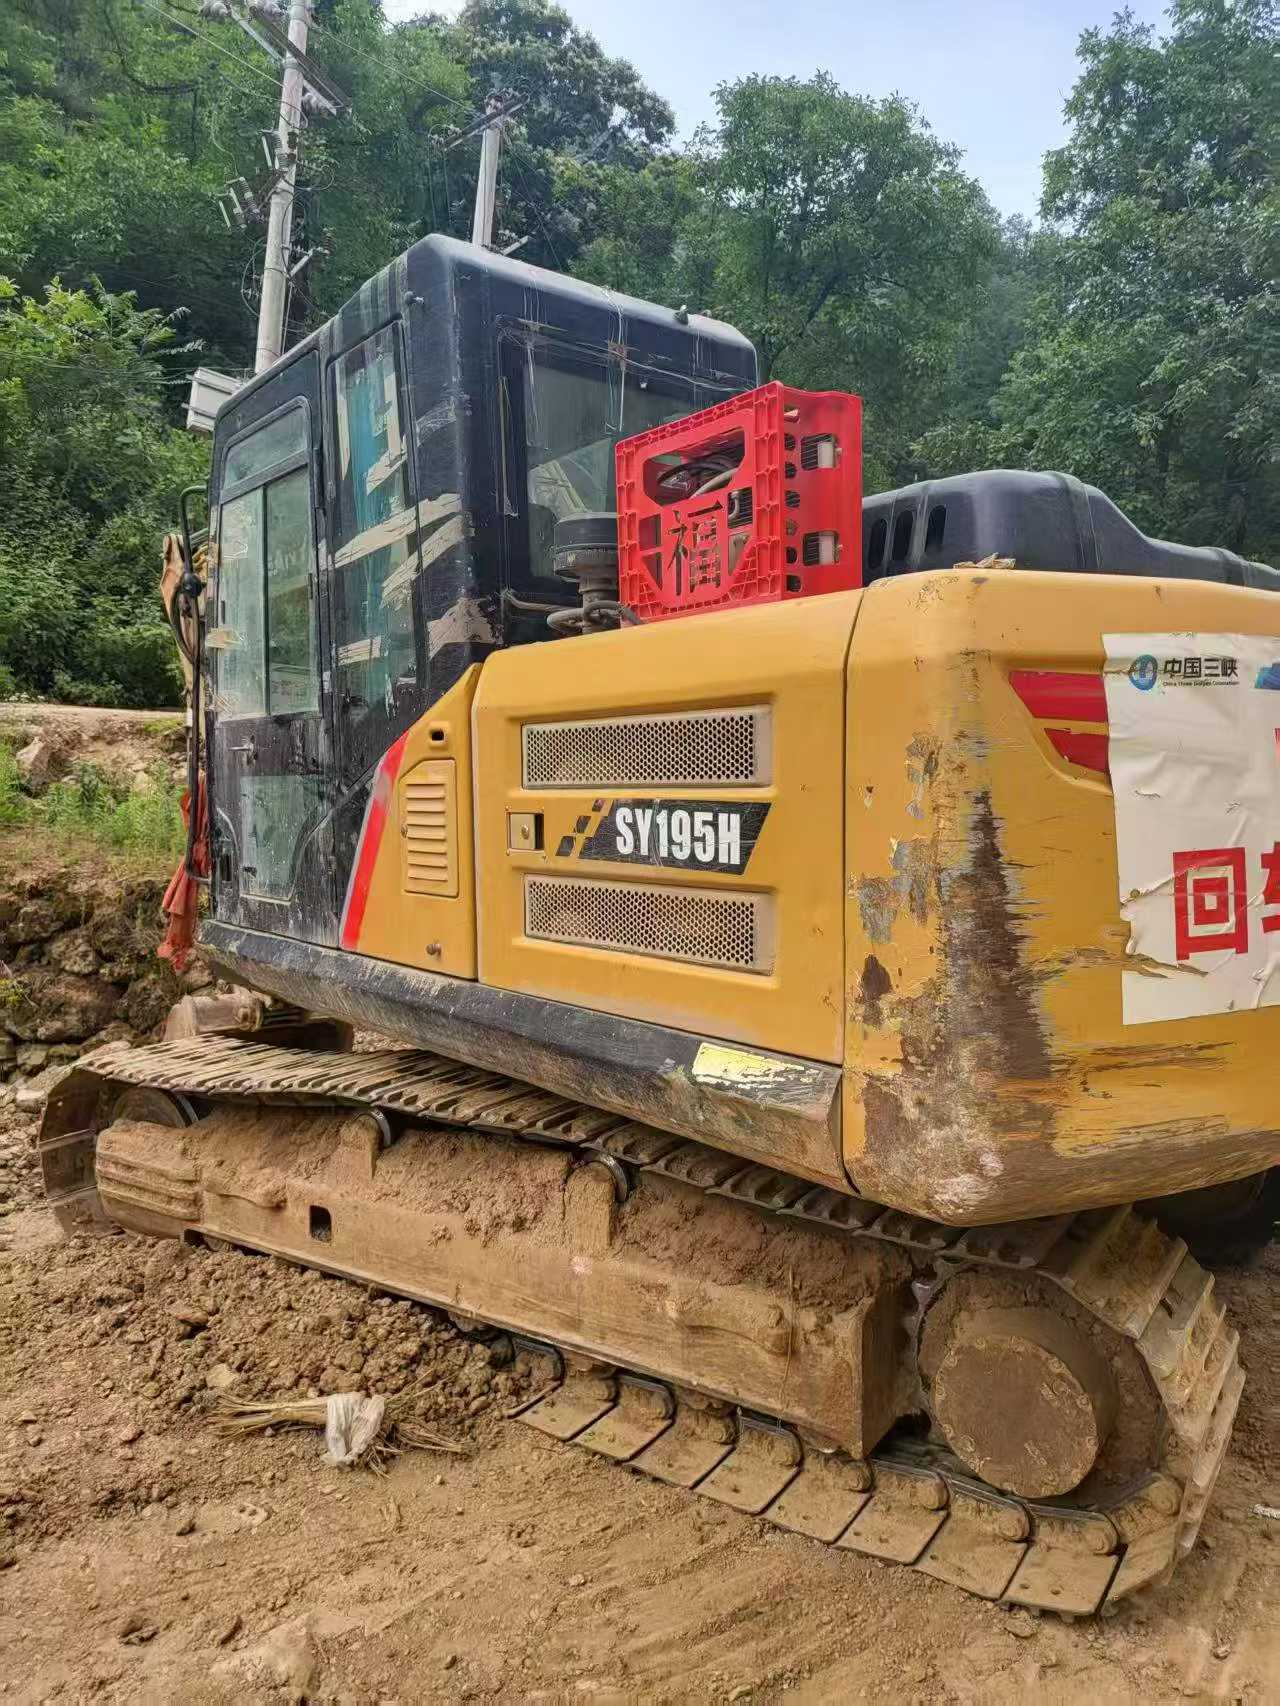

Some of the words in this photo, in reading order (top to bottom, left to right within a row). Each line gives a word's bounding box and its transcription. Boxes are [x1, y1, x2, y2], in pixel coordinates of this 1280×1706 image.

[665, 499, 724, 596] 福
[1163, 656, 1239, 679] 中国三峡
[615, 806, 741, 865] SY195H
[1173, 841, 1280, 960] 回
